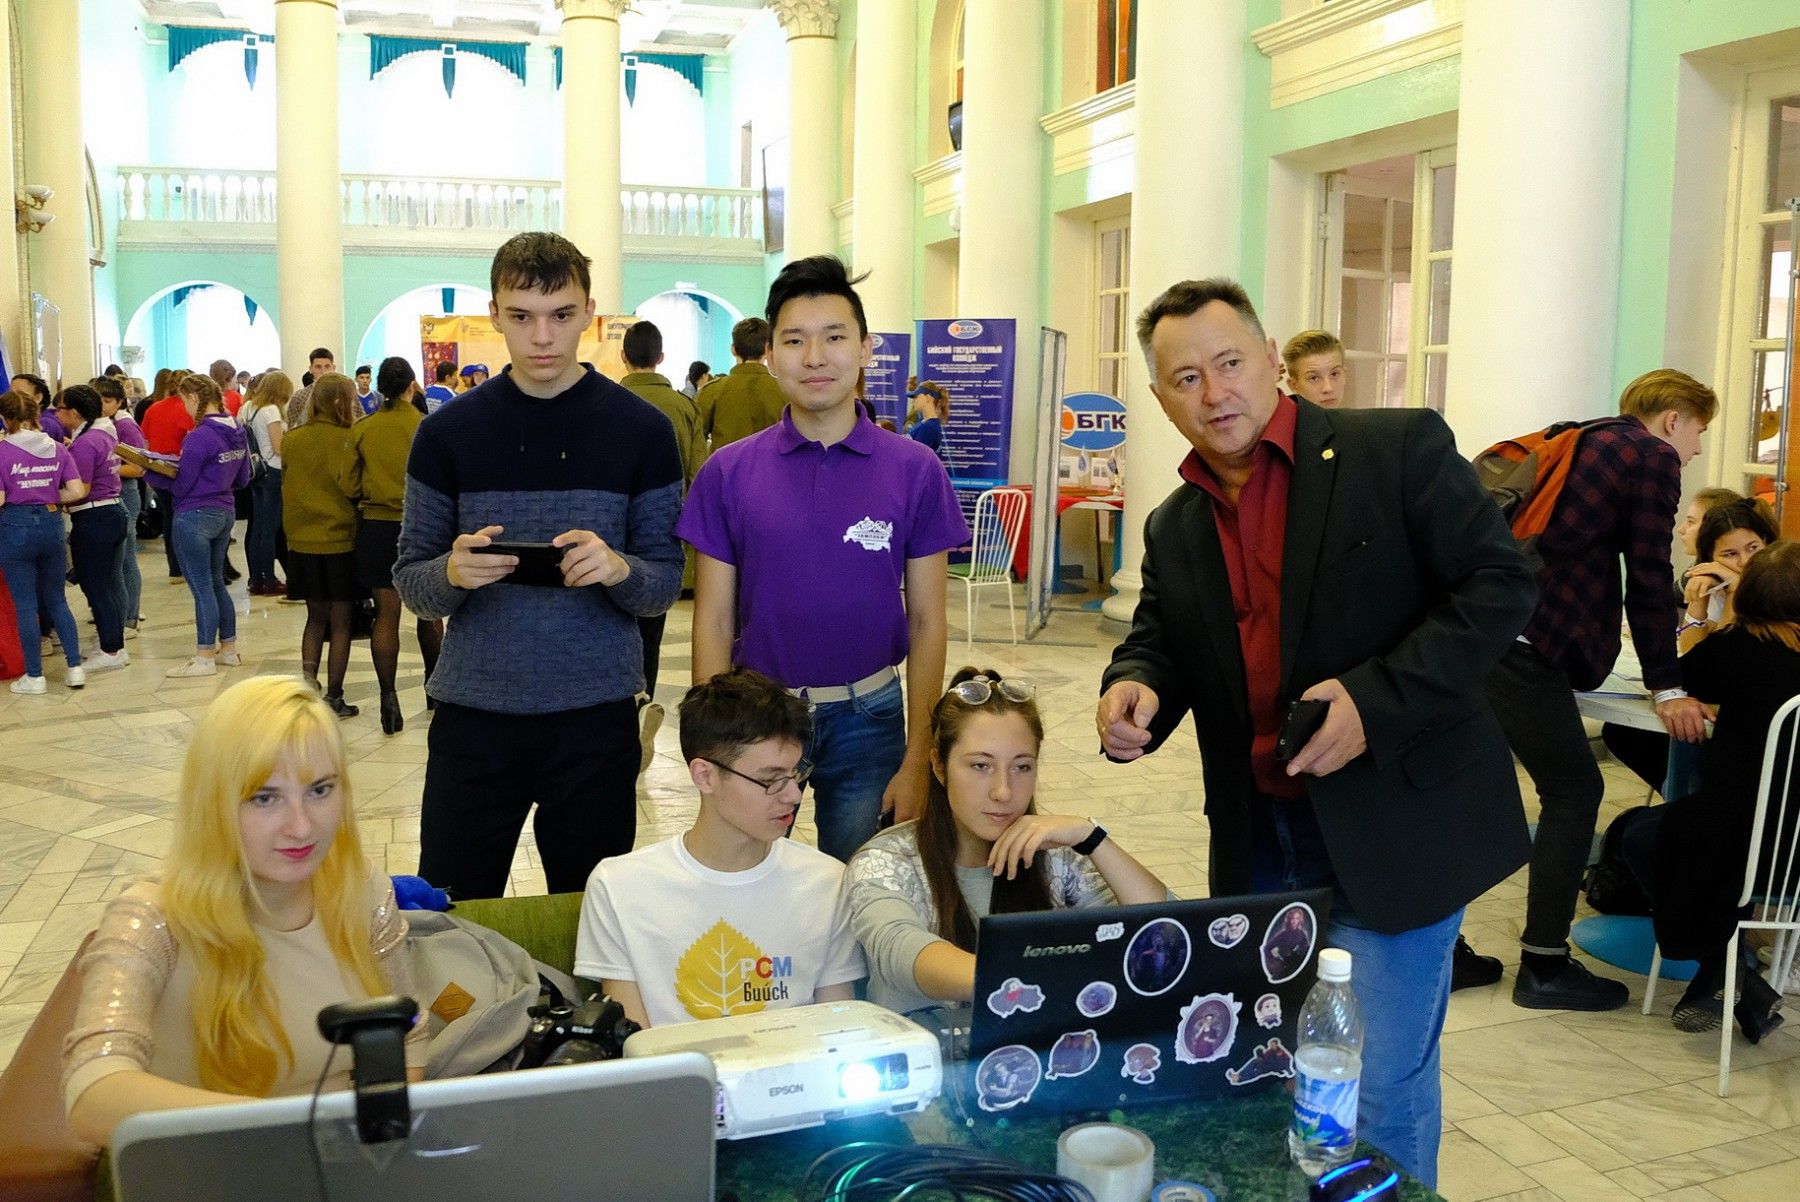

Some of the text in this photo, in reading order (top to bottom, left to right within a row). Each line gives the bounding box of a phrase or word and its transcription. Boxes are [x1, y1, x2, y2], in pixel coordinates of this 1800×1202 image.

[1077, 413, 1126, 430] БГК
[10, 462, 31, 477] Мир
[1022, 943, 1091, 958] lenovo
[740, 956, 792, 979] РСМ
[769, 1084, 804, 1097] EPSON
